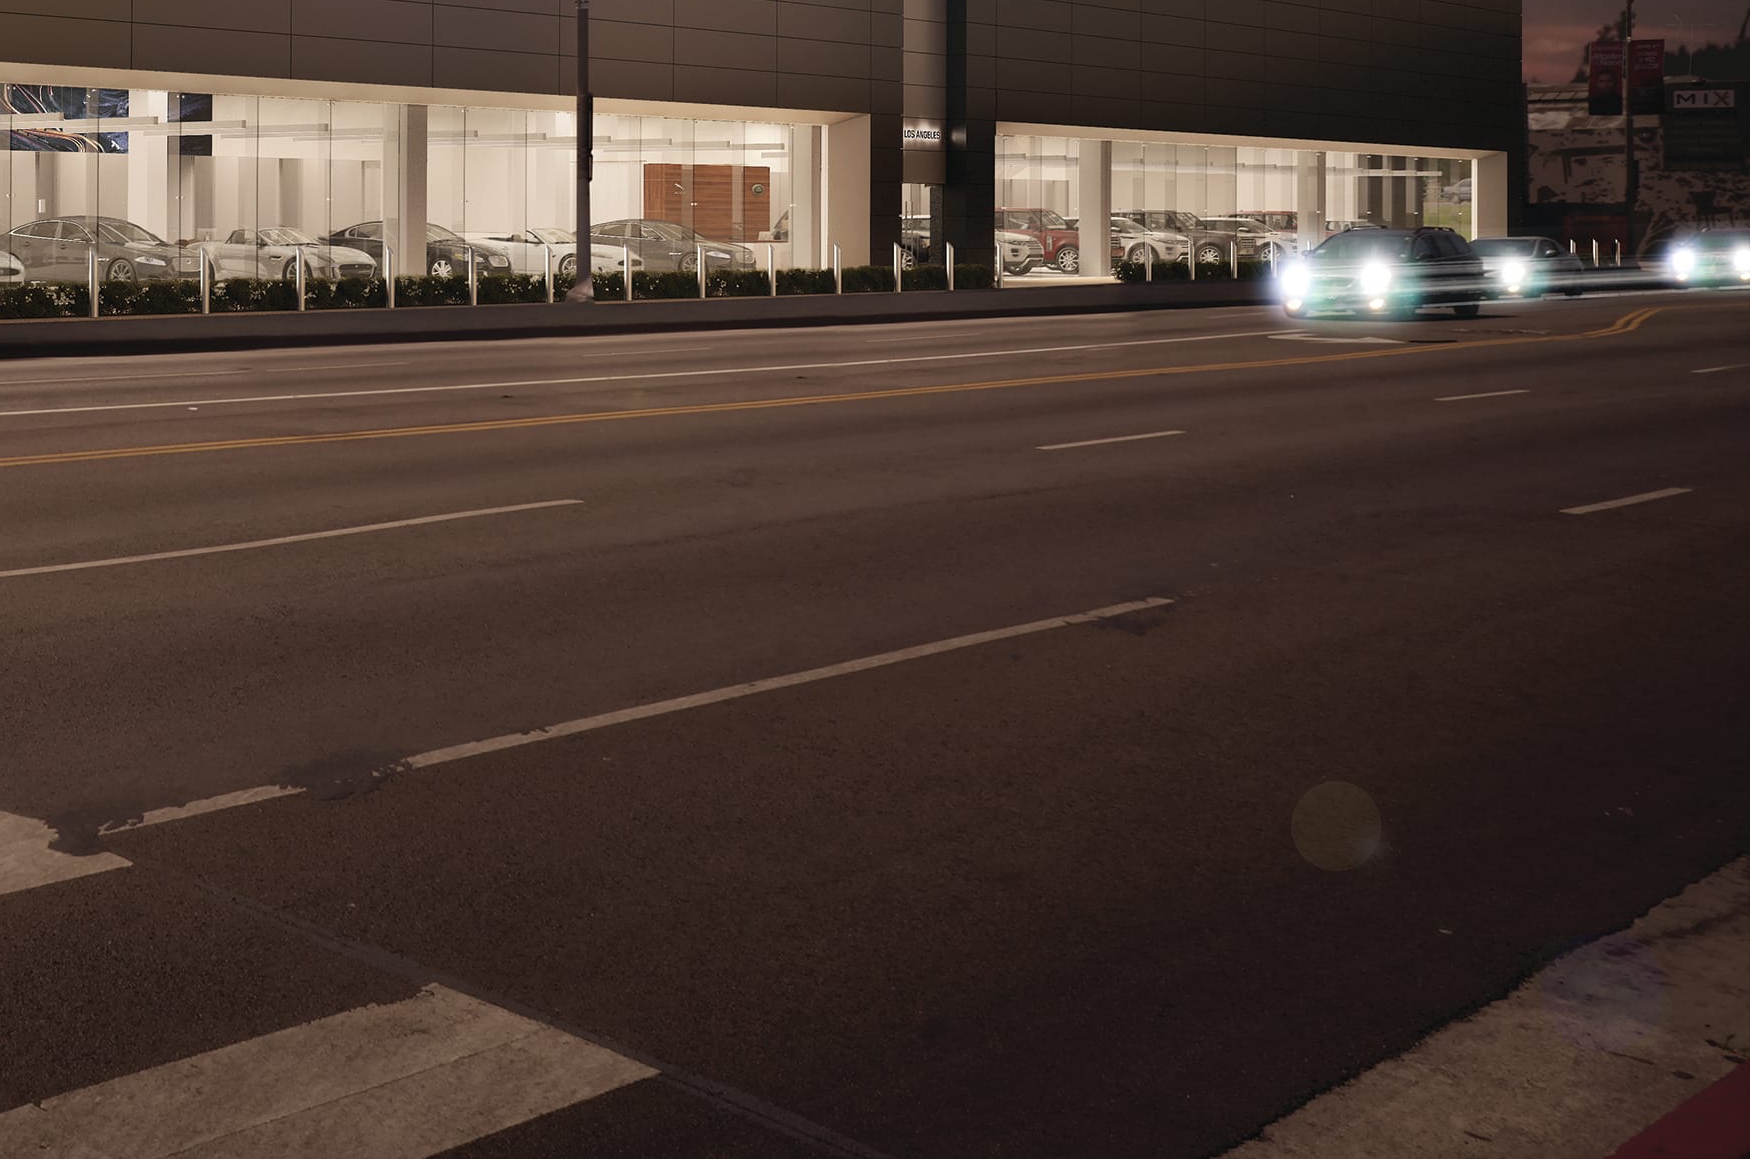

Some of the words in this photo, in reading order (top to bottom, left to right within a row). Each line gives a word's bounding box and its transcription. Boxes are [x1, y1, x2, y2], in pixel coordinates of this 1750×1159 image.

[1676, 91, 1729, 106] MIX
[903, 129, 916, 139] LOS
[915, 129, 941, 140] ANGELES
